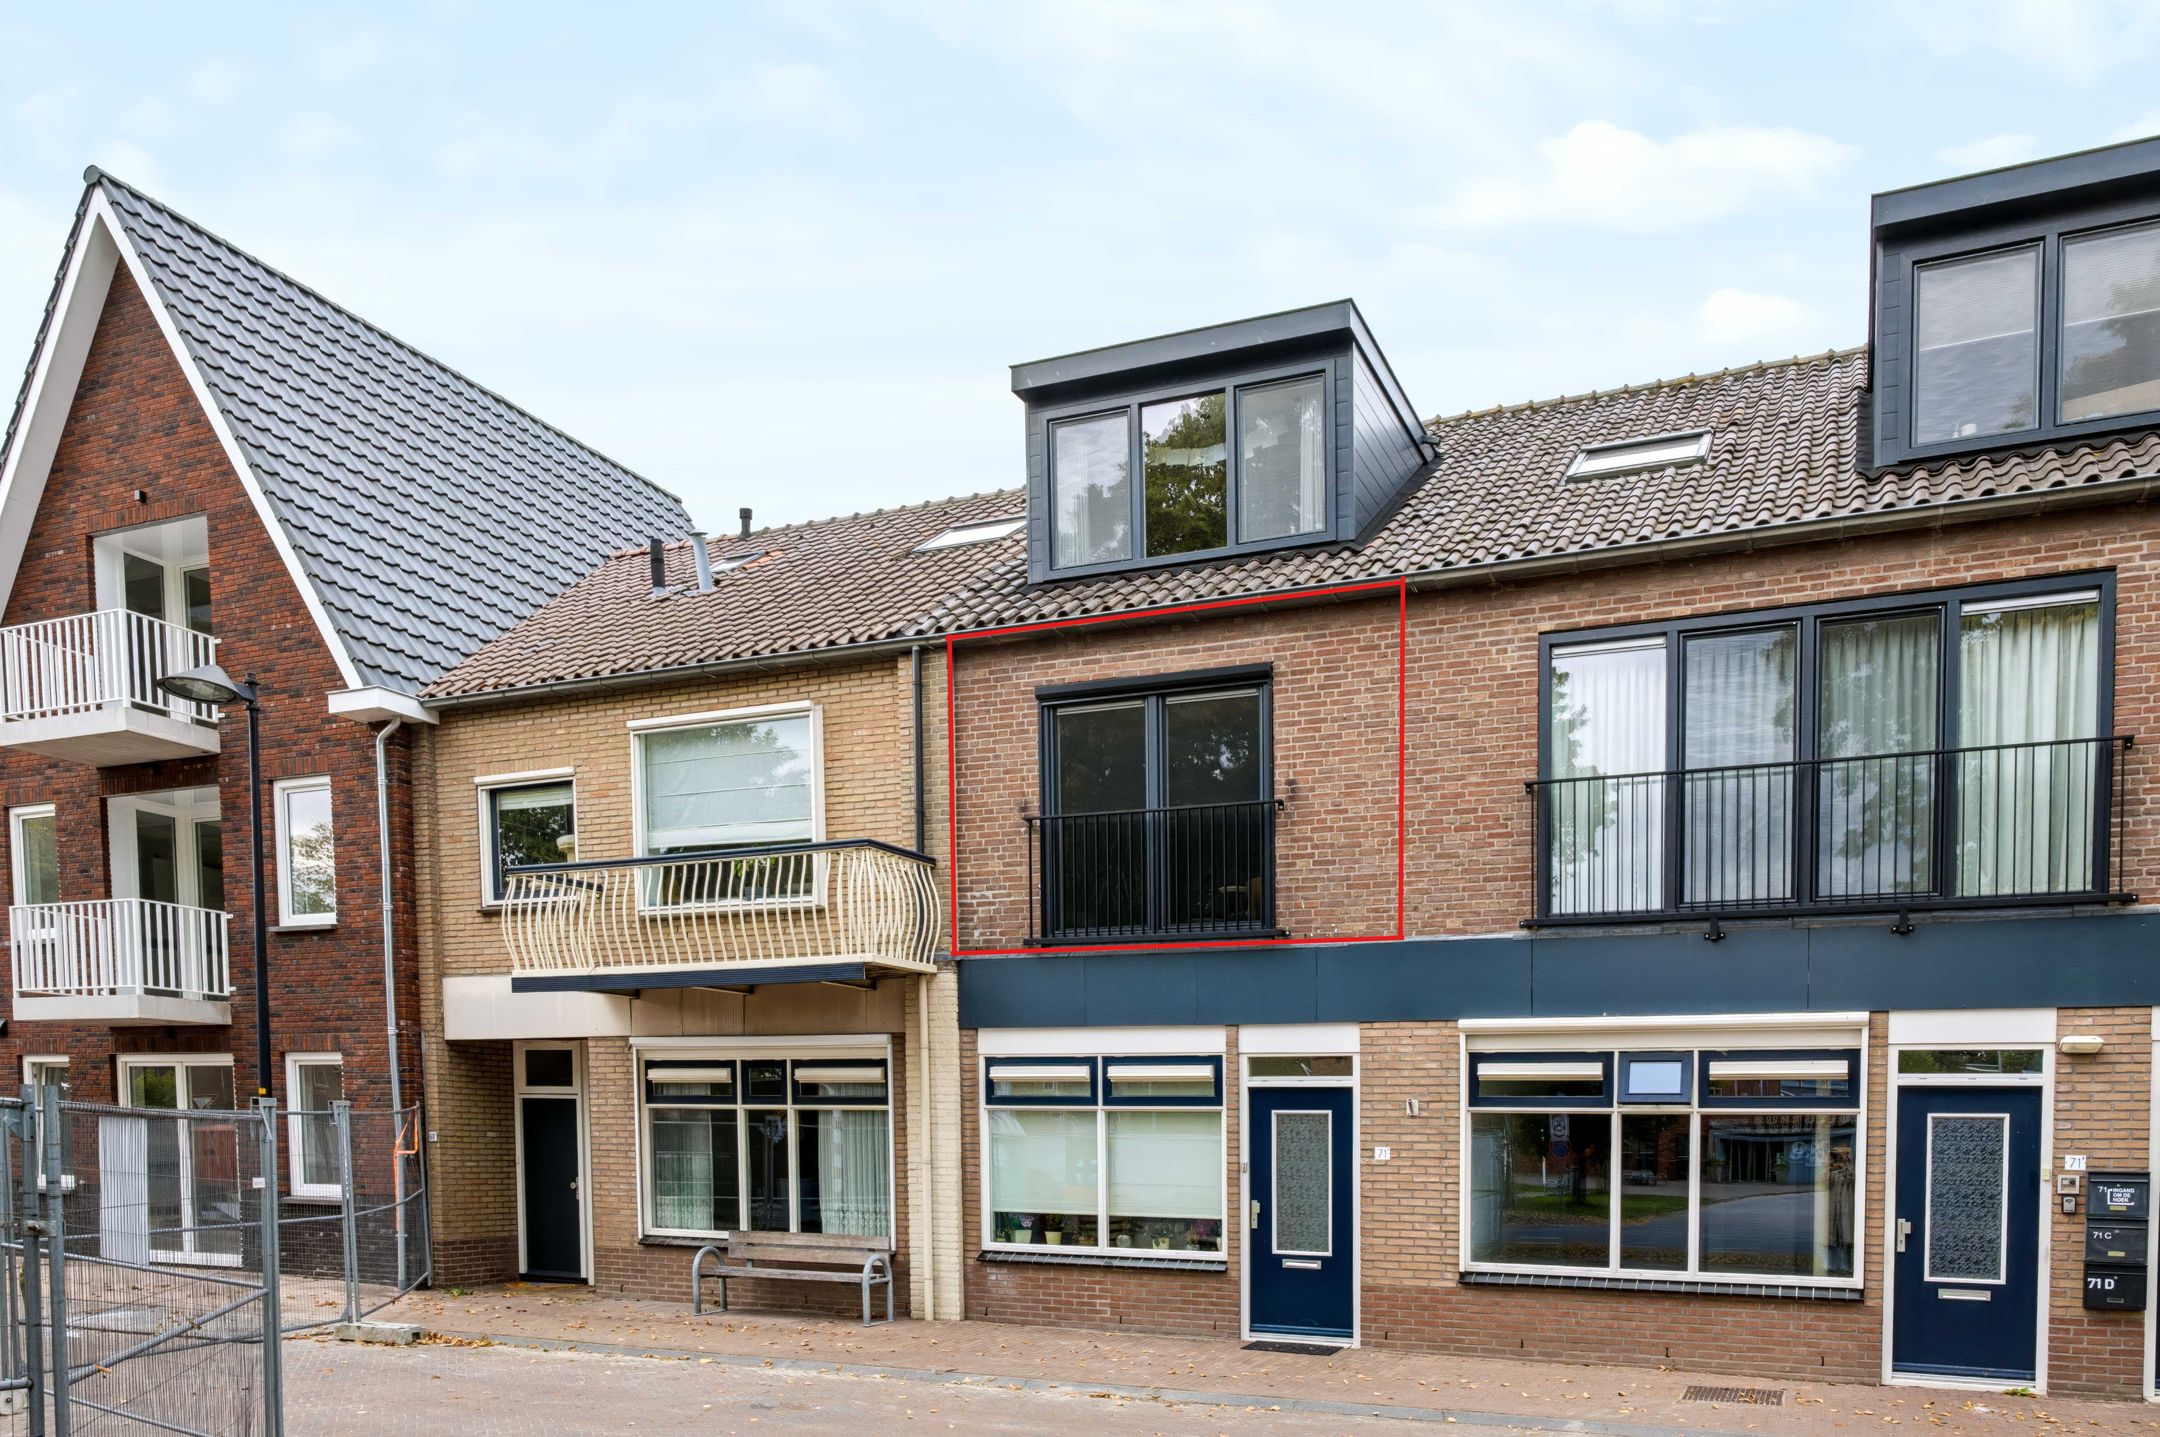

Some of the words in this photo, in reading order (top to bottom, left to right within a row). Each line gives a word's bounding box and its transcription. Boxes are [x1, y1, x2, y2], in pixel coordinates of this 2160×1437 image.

[2104, 1232, 2112, 1240] C
[2087, 1278, 2101, 1289] 71
[2104, 1279, 2115, 1290] D
